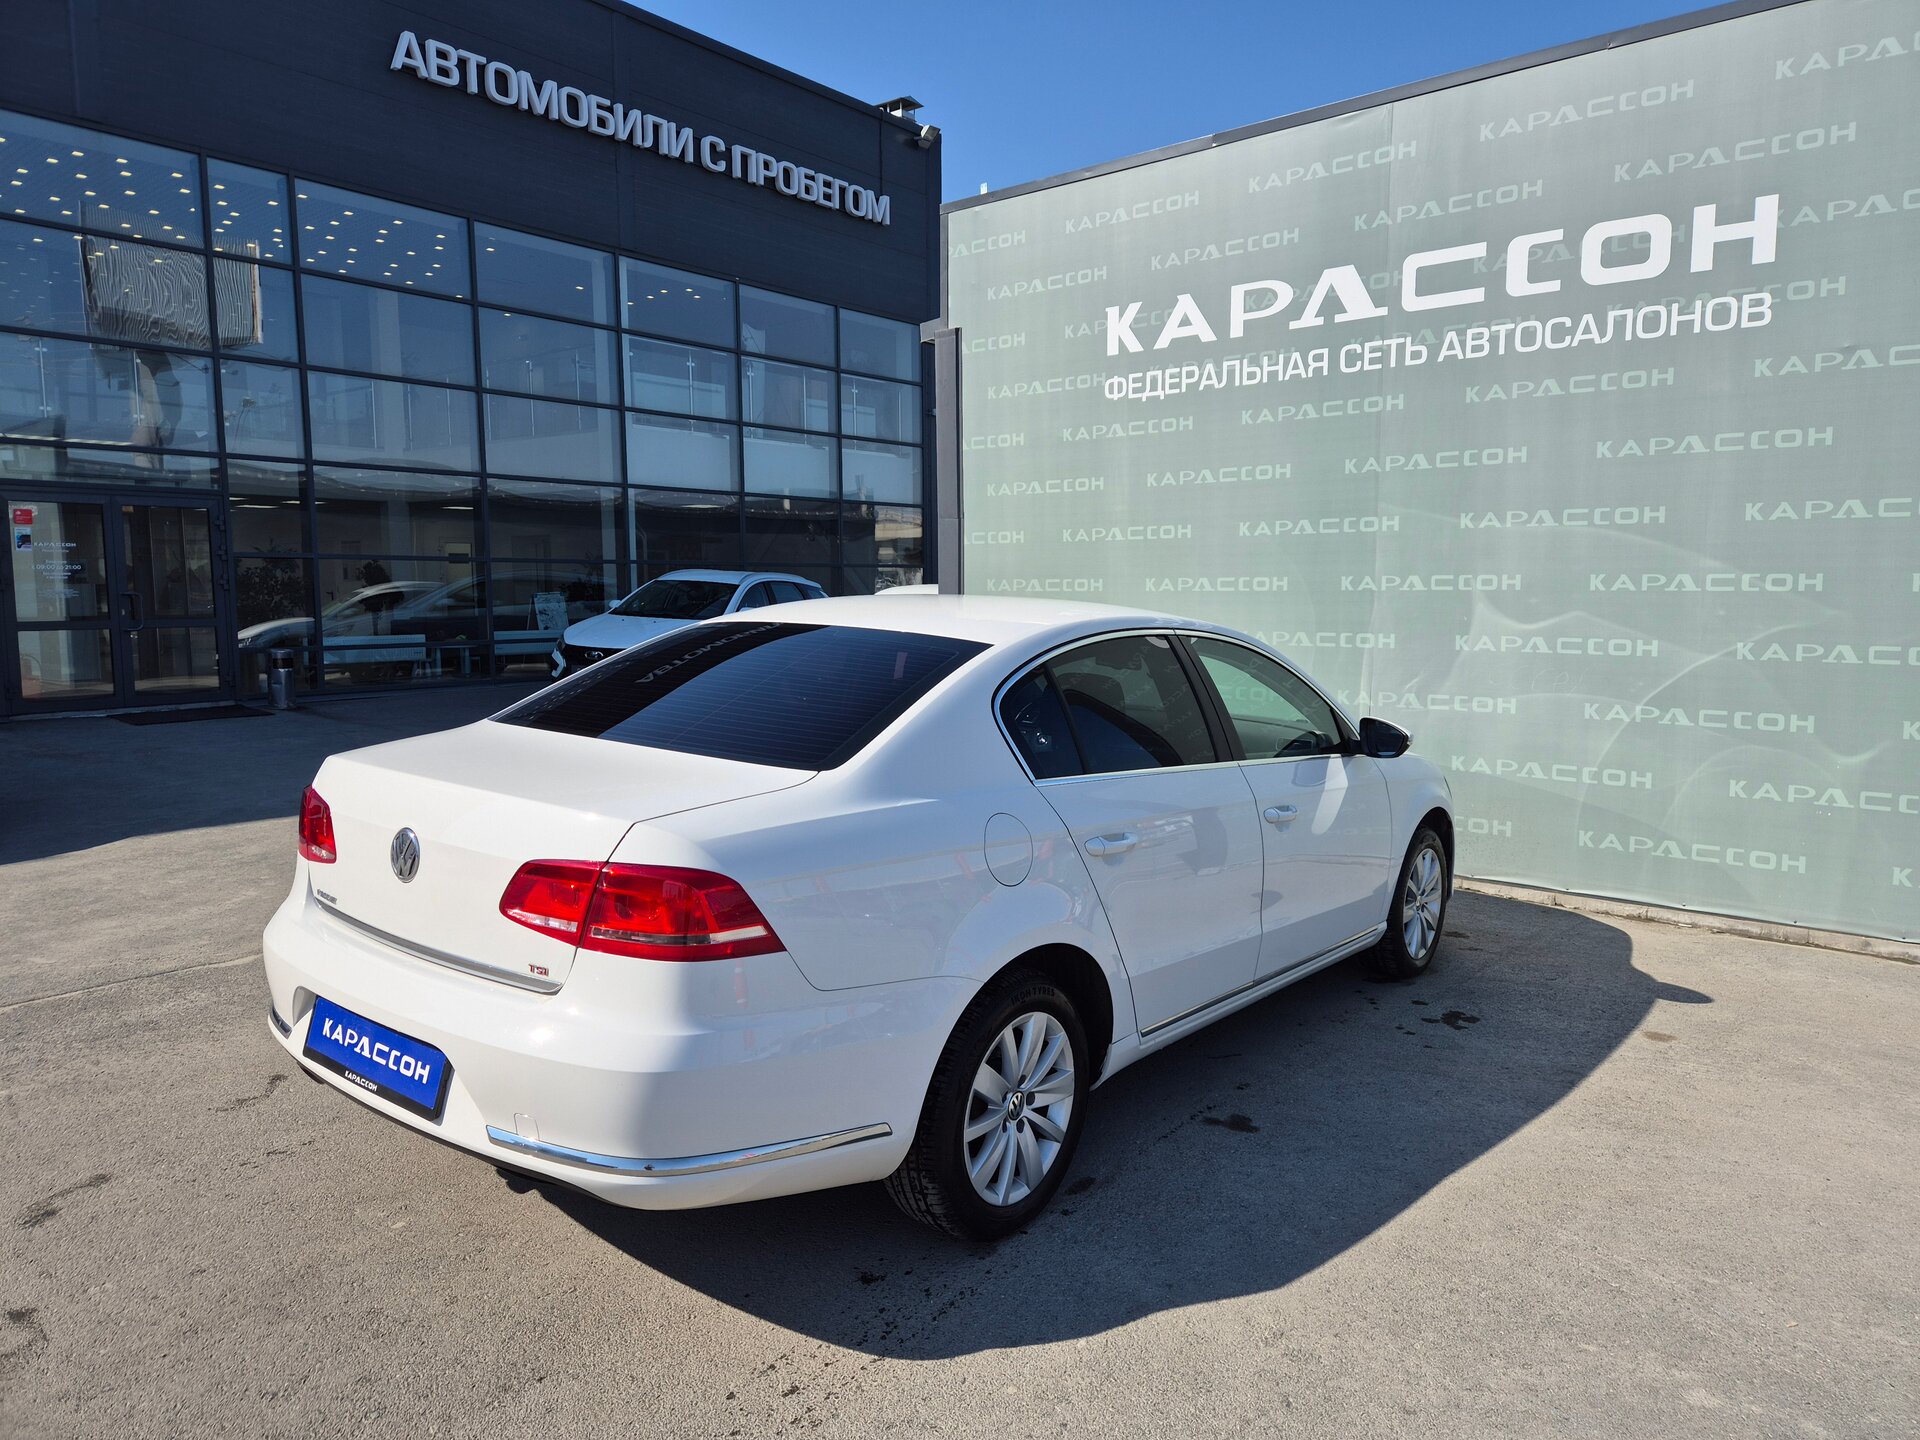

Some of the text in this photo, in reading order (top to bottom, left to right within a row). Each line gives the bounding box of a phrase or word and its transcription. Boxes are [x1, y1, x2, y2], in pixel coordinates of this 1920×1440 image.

[1775, 30, 1920, 80] КАРА
[1480, 79, 1694, 142] КАРАССОН
[390, 30, 890, 226] АВТОМОБИЛИ С ПРОБЕГОМ
[1614, 122, 1857, 182] КАРАССОН
[1248, 140, 1417, 194] КАРАССОН
[1065, 190, 1200, 234] КАРАССОН
[1354, 179, 1543, 232] КАРАССОН
[949, 230, 1026, 258] АССОН
[1151, 227, 1299, 271] КАРАССОН
[987, 266, 1107, 301] КАРАССОН
[1106, 194, 1779, 355] КАРАССОН
[1104, 293, 1772, 401] ФЕДЕРАЛЬНАЯ СЕТЬ АВТОСАЛОНОВ
[988, 374, 1106, 400] КАРАССОН
[1465, 367, 1675, 403] КАРАССОН
[1241, 394, 1404, 425] КАРАССОН
[1063, 416, 1193, 442] КАРАССОН
[1596, 426, 1833, 459] КАРАССОН
[1345, 446, 1527, 475] КАРАССОН
[987, 477, 1104, 497] КАРАССОН
[1147, 463, 1291, 488] КАРАССОН
[1460, 505, 1666, 529] КАРАССОН
[1744, 498, 1920, 520] КАРАС
[1062, 524, 1192, 543] КАРАССОН
[1239, 515, 1400, 537] КАРАССОН
[987, 578, 1103, 592] КАРАССОН
[1145, 576, 1288, 593] КАРАССОН
[1341, 574, 1521, 592] КАРАССОН
[1590, 573, 1823, 592] КАРАССОН
[1243, 631, 1395, 649] АРАССОН
[1455, 634, 1658, 657] КАРАССОН
[1337, 688, 1516, 714] КАРАССОН
[1584, 703, 1814, 734] КАРАССОН
[1452, 755, 1652, 789] КАРАССОН
[1579, 830, 1806, 873] КАРАССОН
[528, 963, 550, 977] TSI
[322, 1017, 431, 1085] КАРАССОН
[344, 1070, 378, 1092] КАРАССОН
